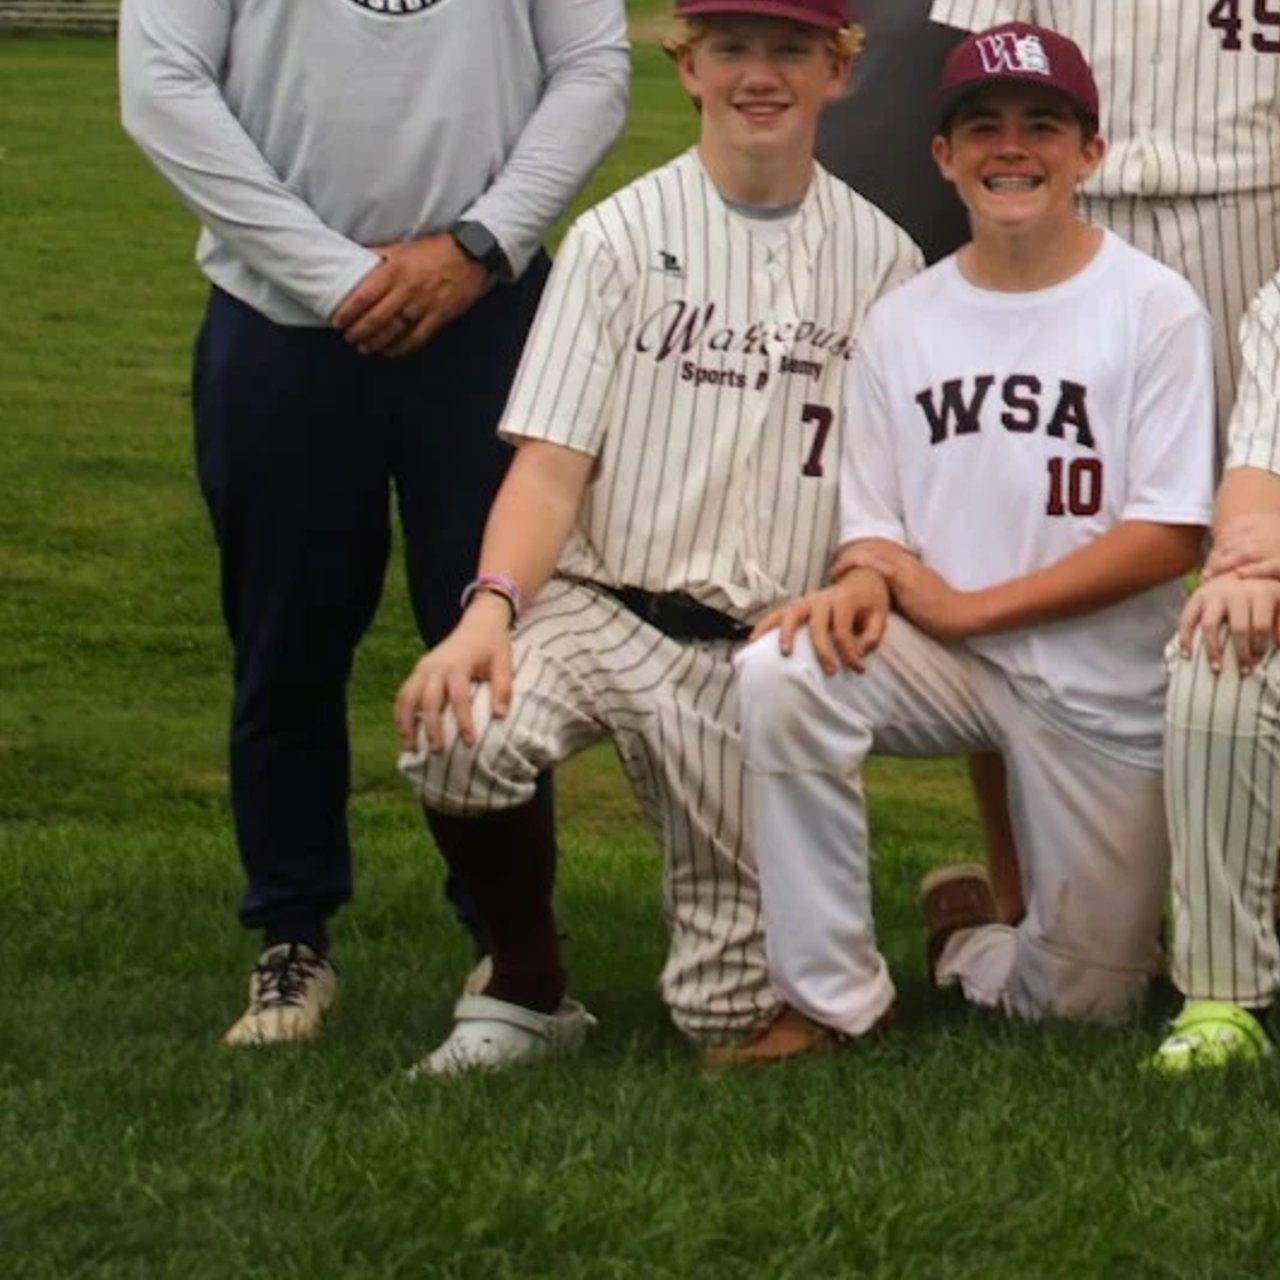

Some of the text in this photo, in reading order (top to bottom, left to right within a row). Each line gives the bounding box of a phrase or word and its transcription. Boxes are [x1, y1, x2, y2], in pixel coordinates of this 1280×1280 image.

[681, 361, 748, 388] Sports
[801, 403, 835, 478] 7
[915, 374, 1097, 449] WSA
[1046, 456, 1105, 517] 10
